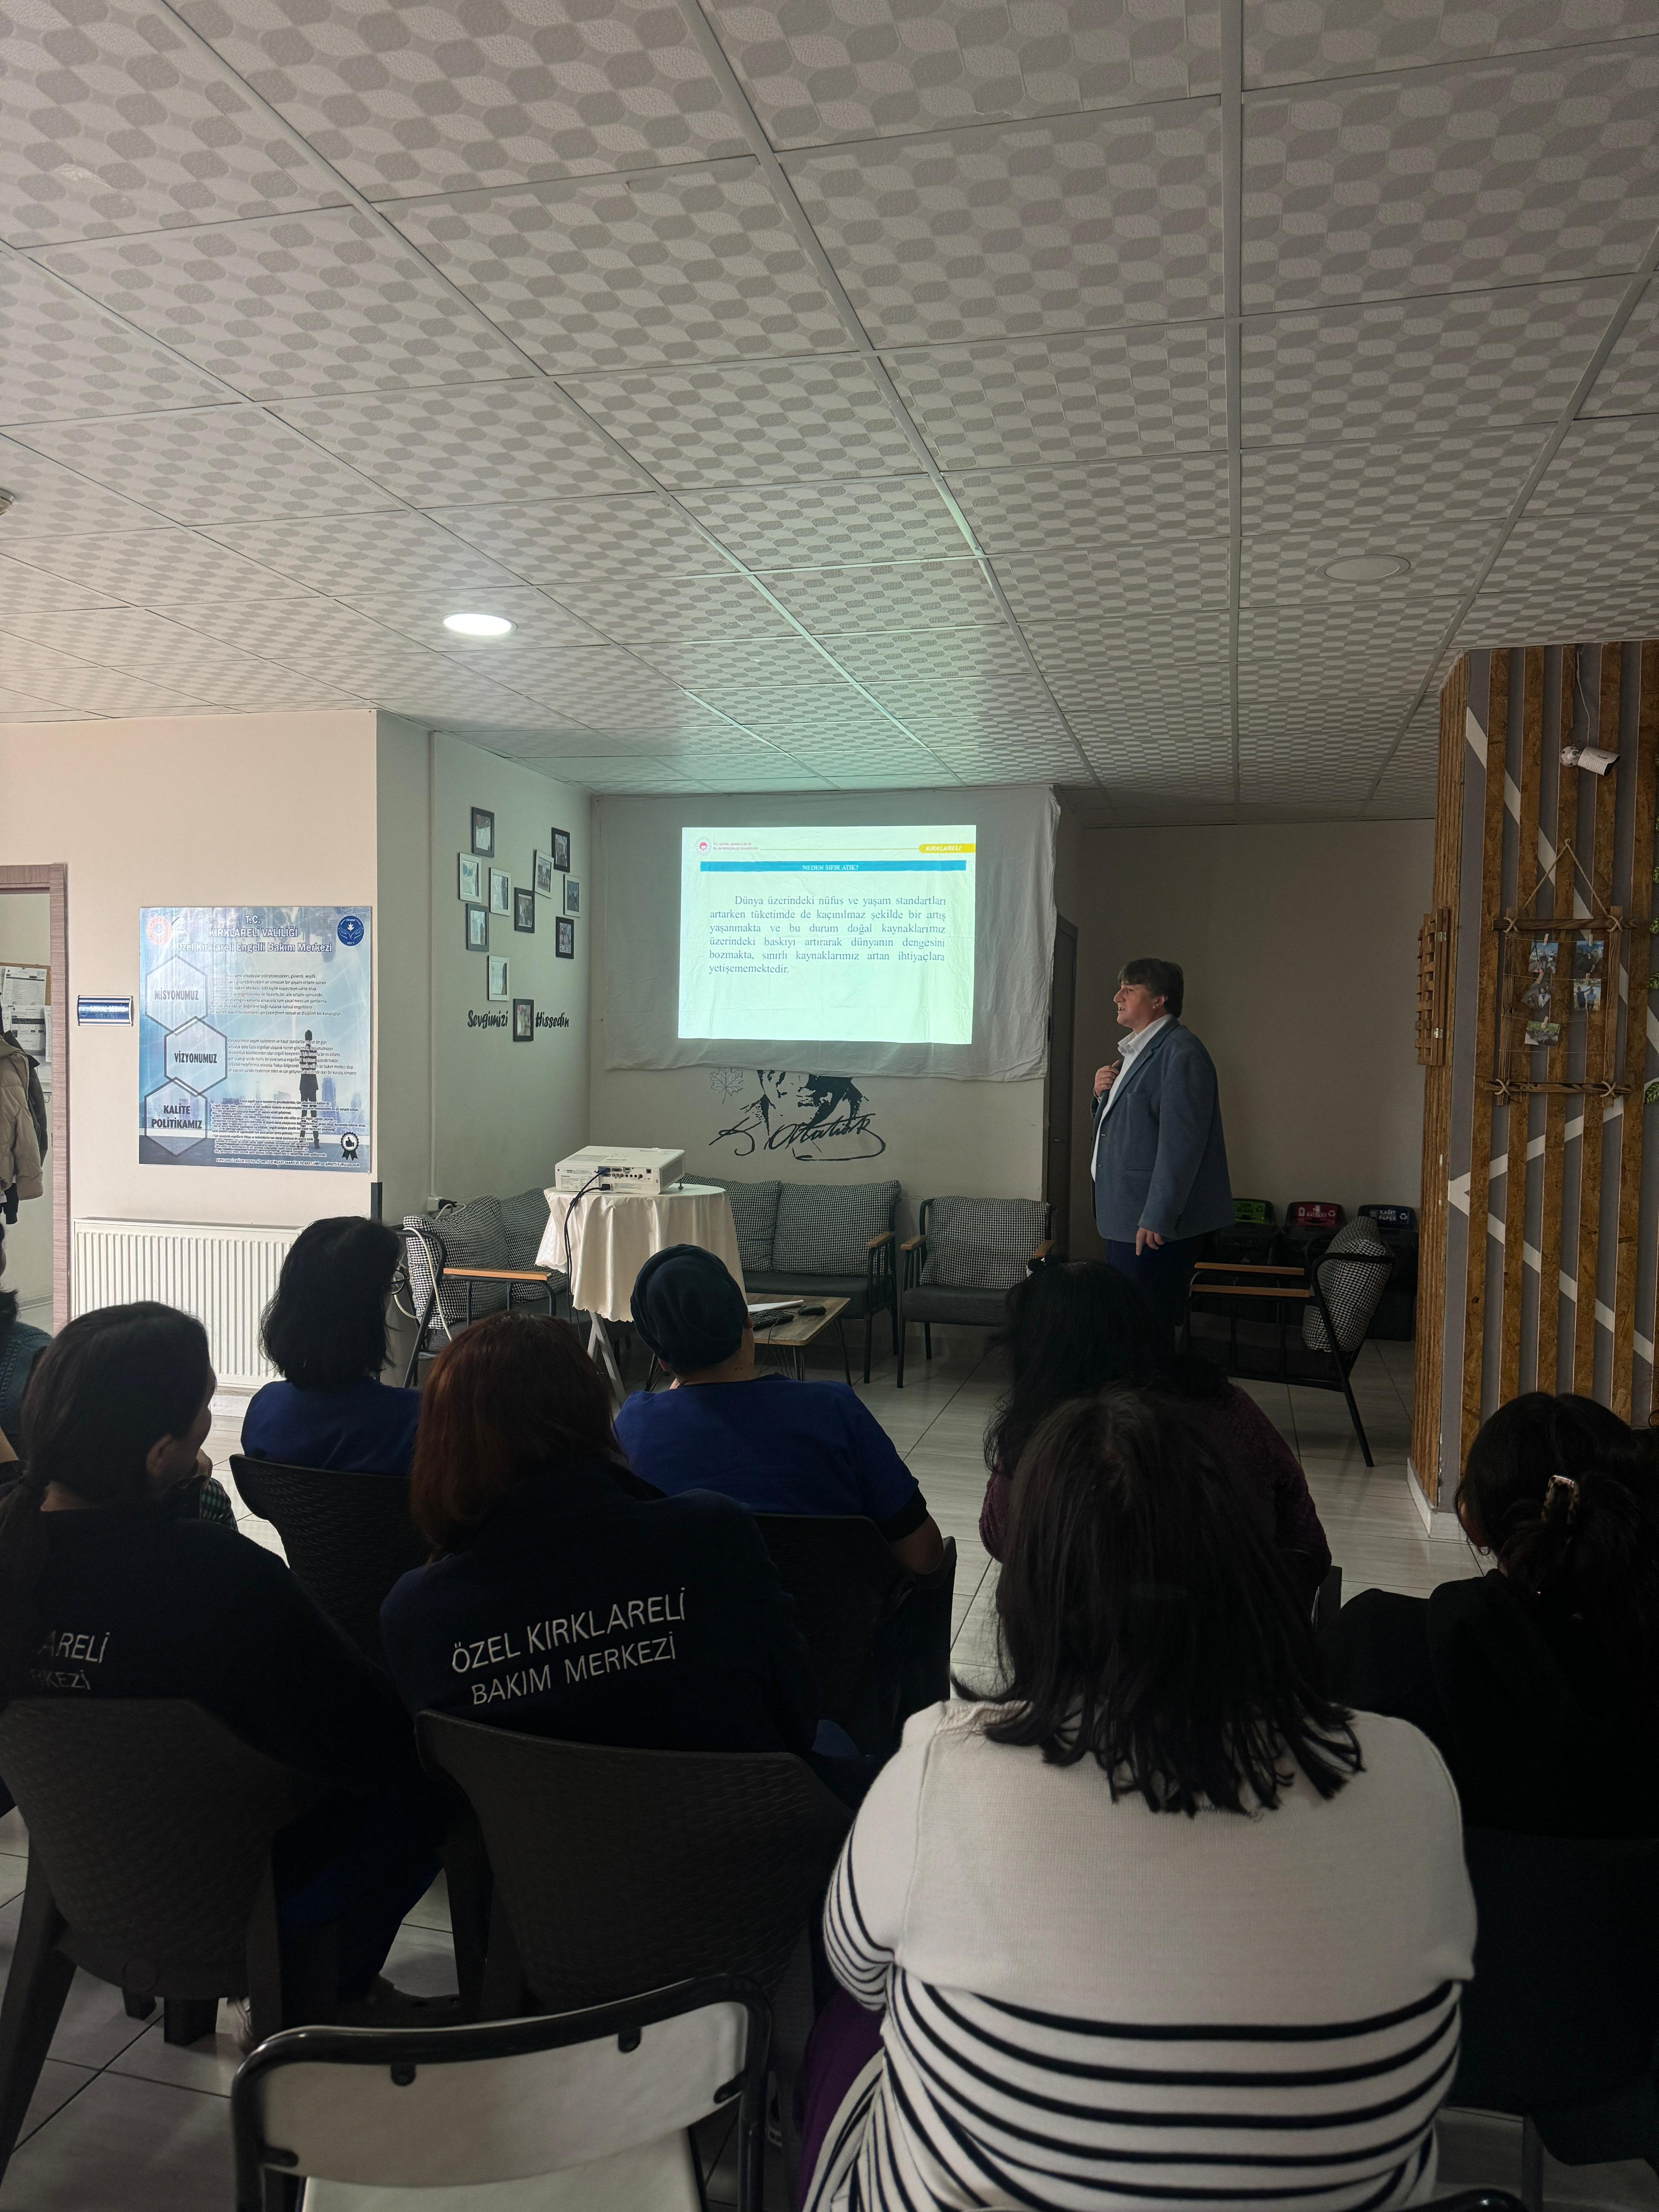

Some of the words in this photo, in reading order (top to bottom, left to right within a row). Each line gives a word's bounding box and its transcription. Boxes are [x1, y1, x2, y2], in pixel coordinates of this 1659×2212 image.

[735, 896, 763, 907] Dünya
[768, 896, 814, 904] üzerindeki
[819, 896, 843, 904] nüfus
[863, 899, 890, 907] yaşam
[896, 896, 945, 905] standartları
[245, 915, 261, 924] T.C.
[710, 910, 745, 918] artarken
[752, 910, 795, 918] tüketimde
[801, 910, 811, 918] de
[817, 910, 865, 920] kaçınılmaz
[871, 909, 903, 920] şekilde
[909, 910, 922, 918] bir
[927, 912, 945, 922] artış
[209, 926, 260, 937] KIRKLARELİ
[261, 926, 298, 937] VALİLİĞİ
[710, 923, 760, 934] yaşanmakta
[790, 923, 800, 932] bu
[810, 924, 838, 932] durum
[848, 924, 871, 934] doğal
[882, 924, 945, 934] kaynaklarımız
[176, 941, 194, 952] Özel
[196, 942, 234, 952] Kırklareli
[236, 942, 265, 954] Engelli
[267, 943, 296, 952] Bakım
[298, 942, 332, 952] Merkezi
[710, 937, 755, 945] üzerindeki
[765, 937, 795, 948] baskıyı
[805, 938, 842, 946] artırarak
[852, 938, 893, 948] dünyanın
[903, 938, 944, 949] dengesini
[710, 950, 754, 960] bozmakta,
[763, 951, 787, 959] sınırlı
[796, 951, 859, 962] kaynaklarımız
[899, 951, 944, 963] ihtiyaçlara
[709, 964, 788, 974] yetişememektedir.
[154, 989, 199, 1000] MİSYONUMUZ
[468, 1010, 508, 1029] Sevgimizi
[535, 1011, 569, 1028] Hissedin
[174, 1051, 217, 1063] VİZYONUMUZ
[164, 1103, 190, 1114] KALİTE
[151, 1117, 202, 1129] POLİTİKAMIZ
[452, 1633, 521, 1673] ÖZEL
[527, 1587, 685, 1654] KIRKLARELİ
[471, 1665, 551, 1705] BAKIM
[565, 1632, 676, 1684] MERKEZİ
